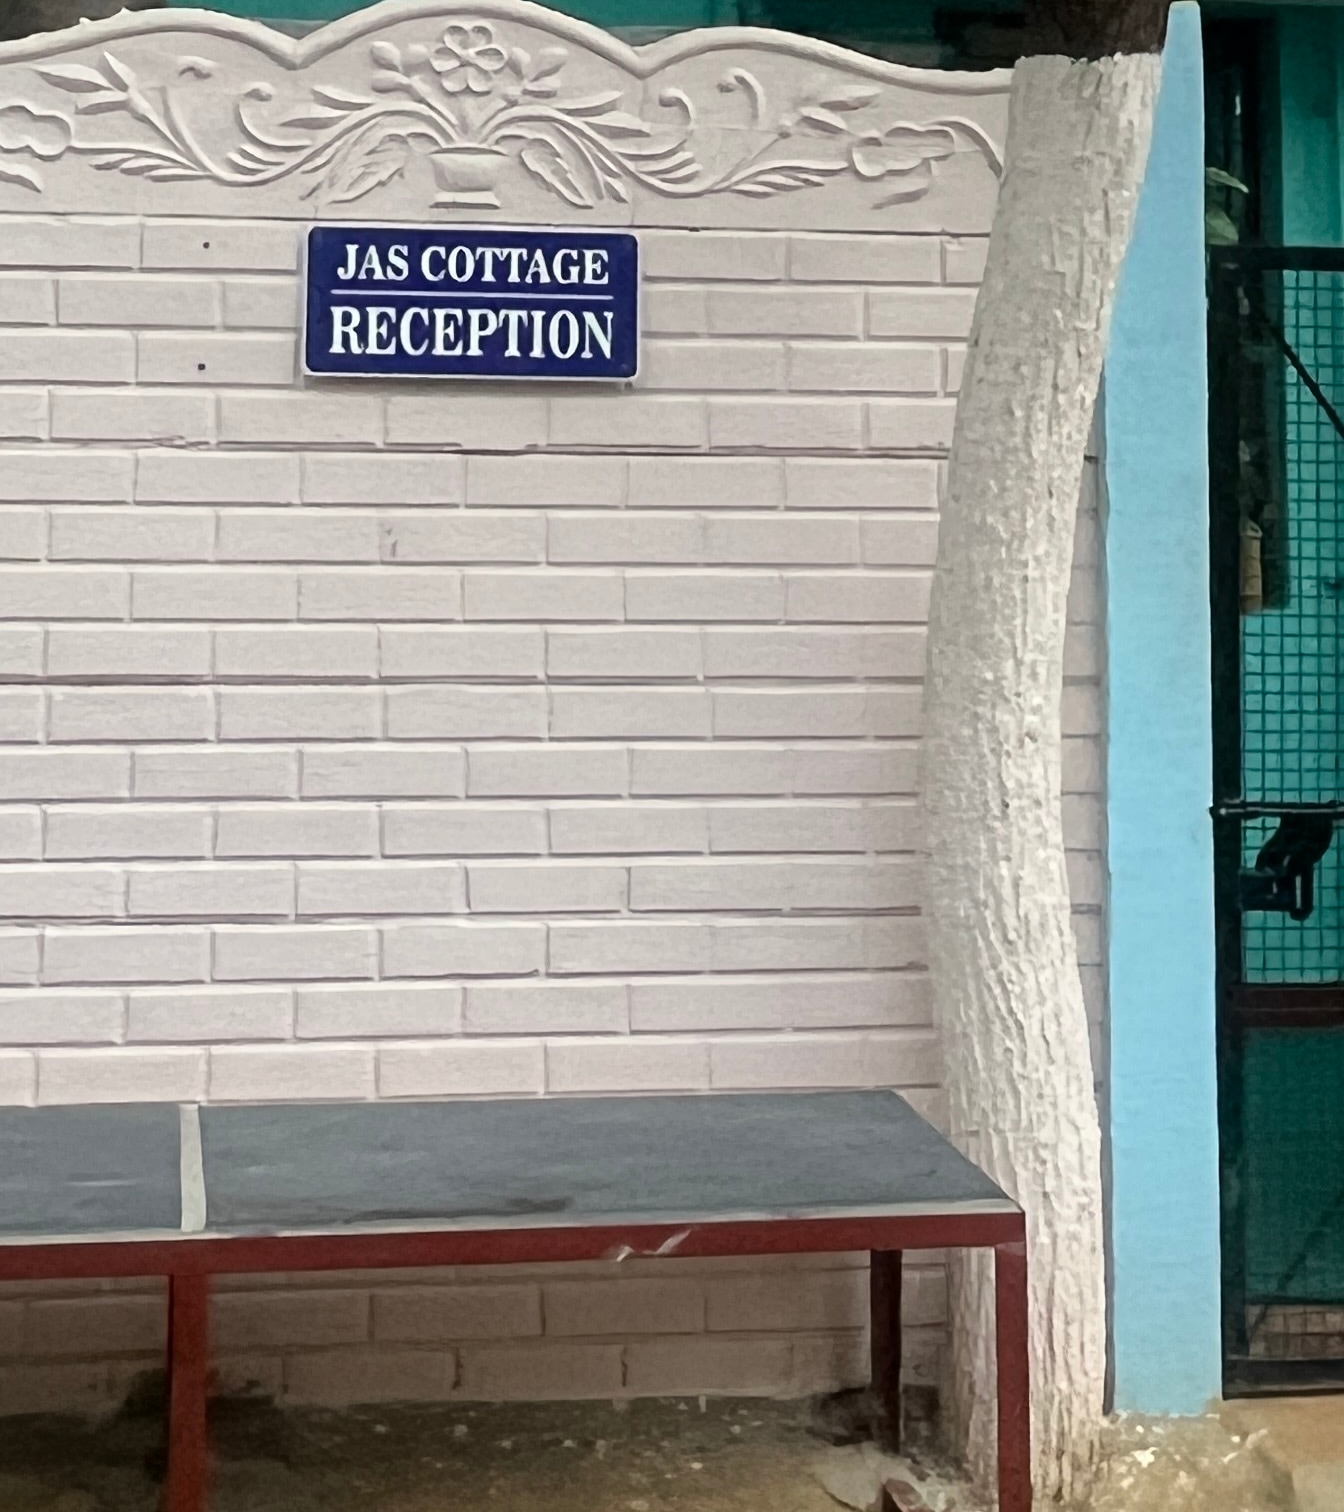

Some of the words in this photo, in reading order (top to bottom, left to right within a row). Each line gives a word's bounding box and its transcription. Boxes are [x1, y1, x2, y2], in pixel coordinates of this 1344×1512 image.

[337, 244, 409, 281] JAS
[421, 246, 609, 285] COTTAGE
[329, 306, 614, 359] RECEPTION
